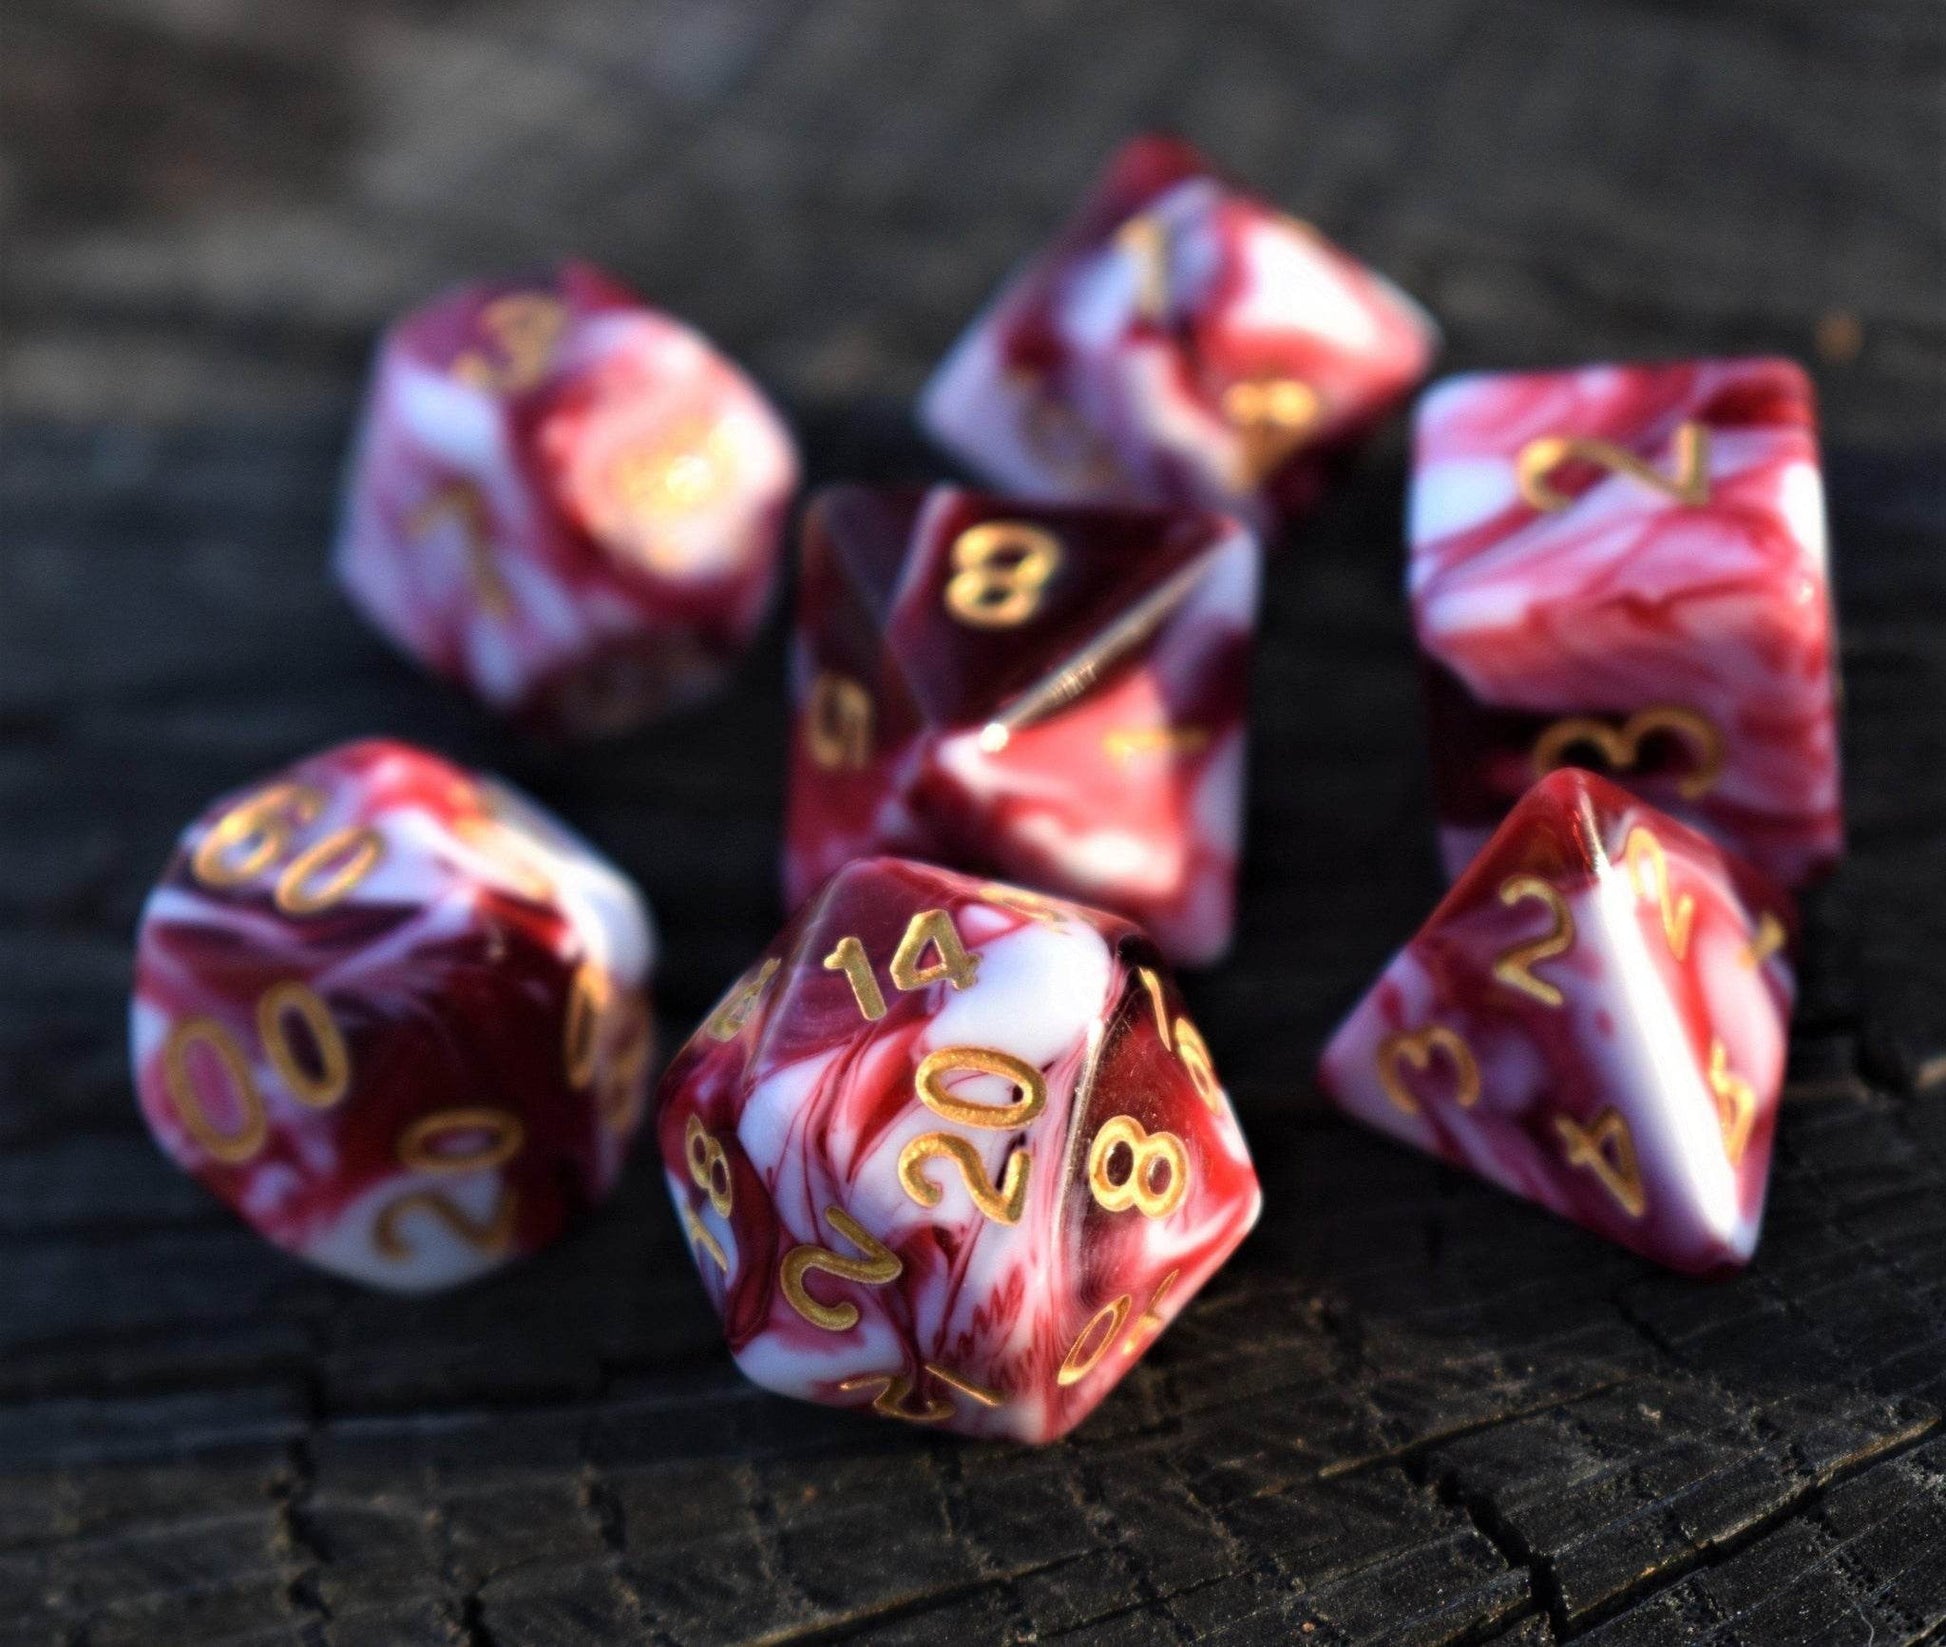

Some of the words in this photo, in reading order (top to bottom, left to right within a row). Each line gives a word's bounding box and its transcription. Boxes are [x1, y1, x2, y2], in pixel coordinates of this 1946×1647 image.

[1516, 421, 1711, 512] 2
[944, 520, 1063, 627] 8
[1533, 705, 1726, 801] 3
[193, 783, 385, 913] 60
[824, 909, 982, 1021] 14
[1492, 875, 1576, 1006] 2
[165, 980, 350, 1163] 00
[1377, 1026, 1481, 1114] 3
[371, 1108, 527, 1262] 20
[898, 1047, 1046, 1225] 20
[1089, 1114, 1189, 1219] 8
[1554, 1107, 1646, 1217] 4
[780, 1206, 902, 1330] 2
